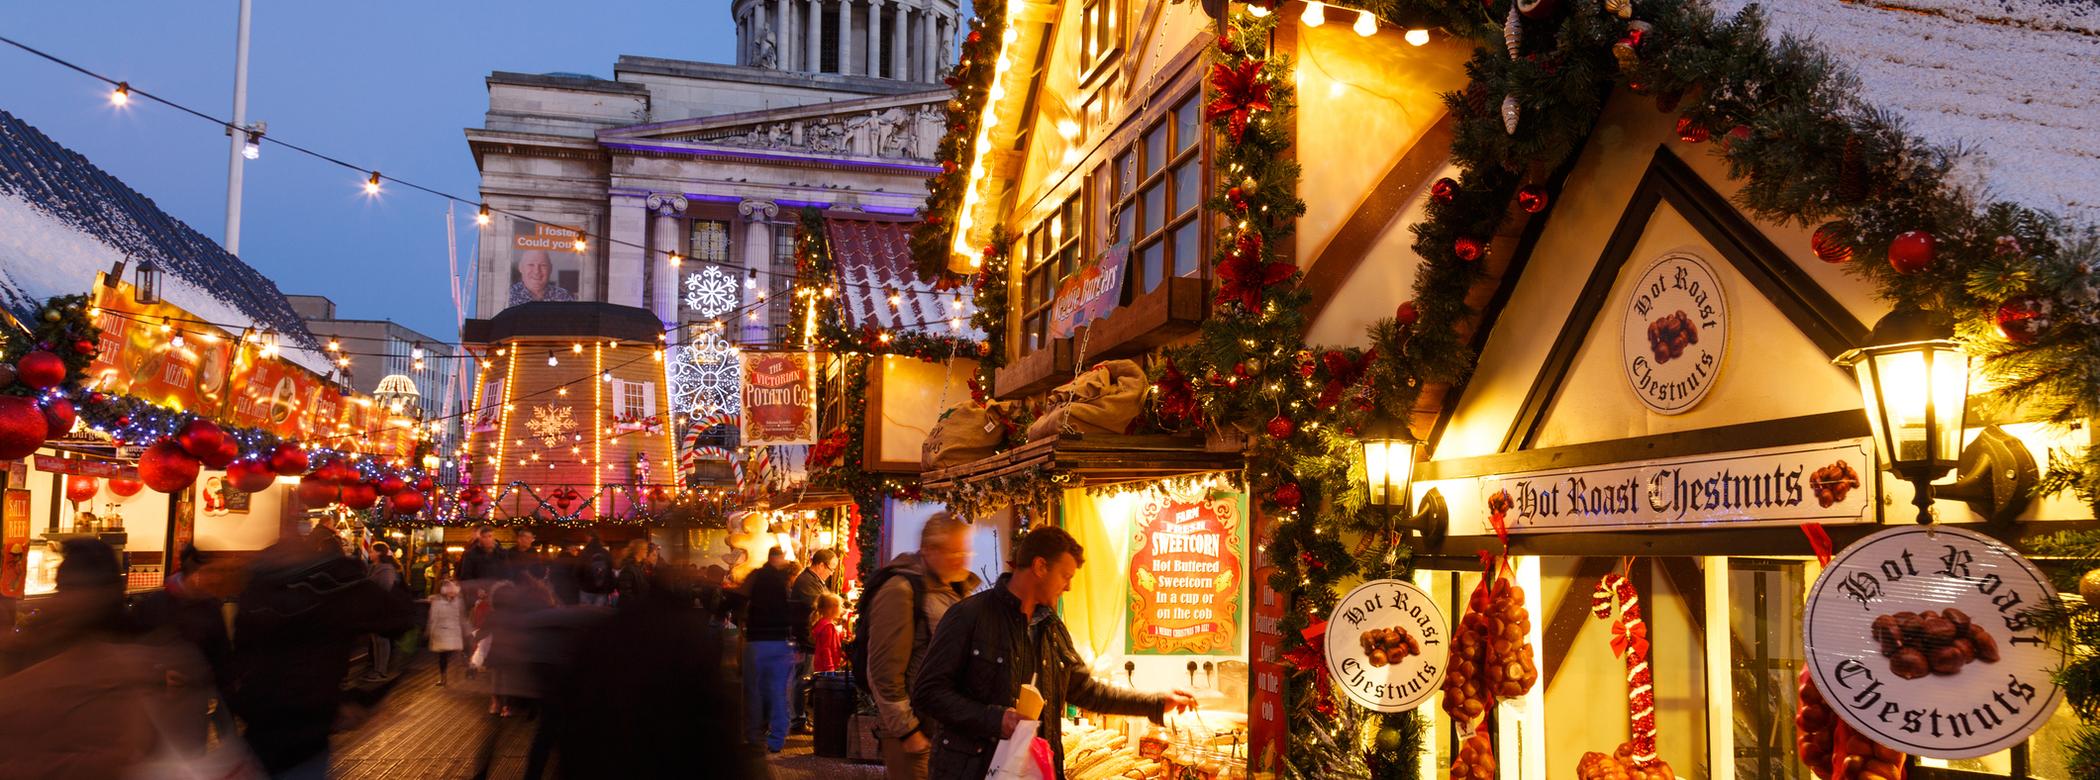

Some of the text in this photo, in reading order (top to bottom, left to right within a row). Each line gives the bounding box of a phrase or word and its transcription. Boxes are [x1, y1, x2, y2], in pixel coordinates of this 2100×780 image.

[539, 226, 543, 235] I
[518, 237, 550, 247] Could
[1634, 265, 1718, 329] Hot Roast
[755, 369, 801, 387] VICTORIAN
[768, 361, 784, 375] THE
[1632, 349, 1714, 402] Chestnuts
[746, 383, 791, 409] POTATO
[1515, 463, 1804, 525] Hot Roast Chestnuts
[1176, 507, 1200, 524] FARM
[1152, 532, 1220, 558] SWEETCORN
[1152, 559, 1220, 573] Hot Buttered
[1158, 575, 1213, 588] Sweetcorn
[1156, 591, 1214, 605] In a cup or
[1837, 544, 2047, 648] Hot Roast
[1157, 607, 1212, 619] on the cob
[1342, 590, 1440, 646] Hot Roast
[1341, 657, 1437, 700] Chestnuts
[1834, 658, 2037, 739] Chestnuts
